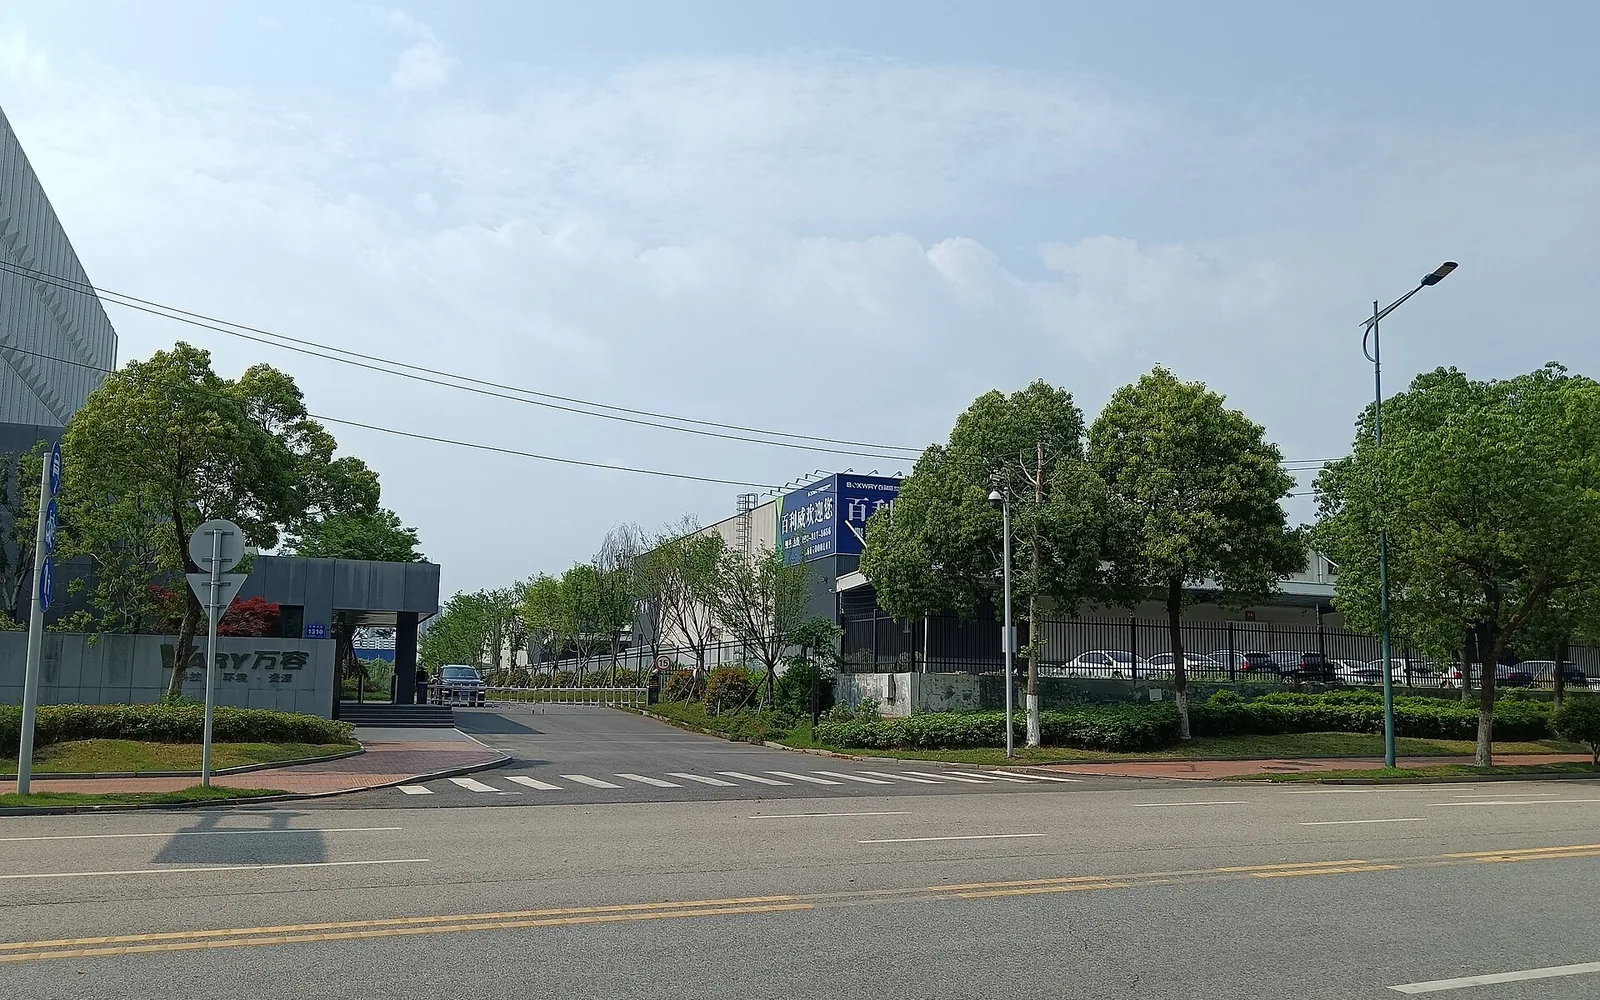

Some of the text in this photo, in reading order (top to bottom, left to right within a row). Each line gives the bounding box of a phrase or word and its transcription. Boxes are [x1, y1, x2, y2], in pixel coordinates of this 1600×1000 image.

[782, 497, 833, 535] 百利威欢迎您
[251, 651, 309, 670] 万容
[659, 659, 668, 667] 15
